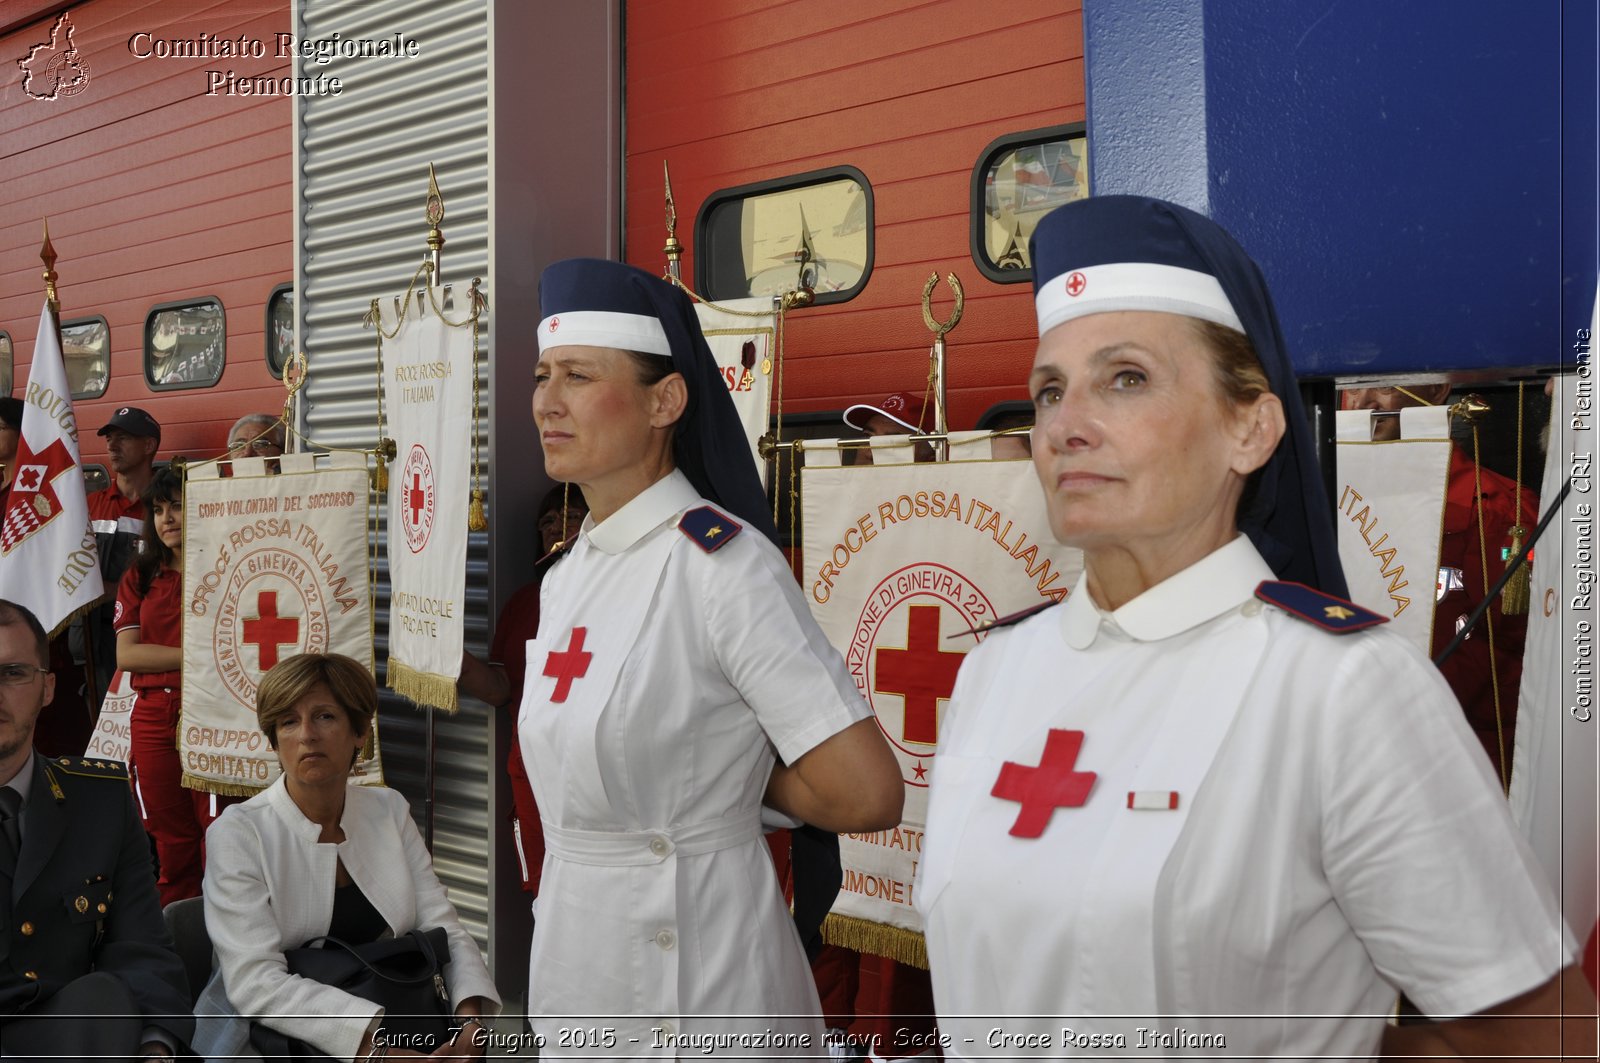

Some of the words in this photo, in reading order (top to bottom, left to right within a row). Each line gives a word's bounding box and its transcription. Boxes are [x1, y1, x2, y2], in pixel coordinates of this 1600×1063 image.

[420, 361, 452, 380] ROSSA
[719, 366, 752, 392] SA
[199, 502, 225, 519] CORPO
[226, 497, 278, 517] VOLONTARI
[284, 496, 303, 512] DEL
[307, 491, 355, 510] SOCCORSO
[813, 514, 878, 604] CROCE
[877, 490, 961, 530] ROSSA
[964, 498, 1068, 604] ITALIANA
[1339, 485, 1411, 618] ITALIANA
[191, 544, 231, 617] CROCE
[229, 517, 292, 553] ROSSA
[295, 523, 358, 615] ITALIANA
[233, 569, 245, 589] DI
[248, 553, 305, 585] GINEVRA
[304, 583, 318, 606] 22
[850, 601, 883, 698] ENZIONE
[879, 584, 896, 607] DI
[897, 570, 962, 602] GINEVRA
[963, 593, 987, 622] 22
[186, 726, 262, 752] GRUPPO
[187, 750, 269, 780] COMITATO
[840, 869, 904, 905] IMONE
